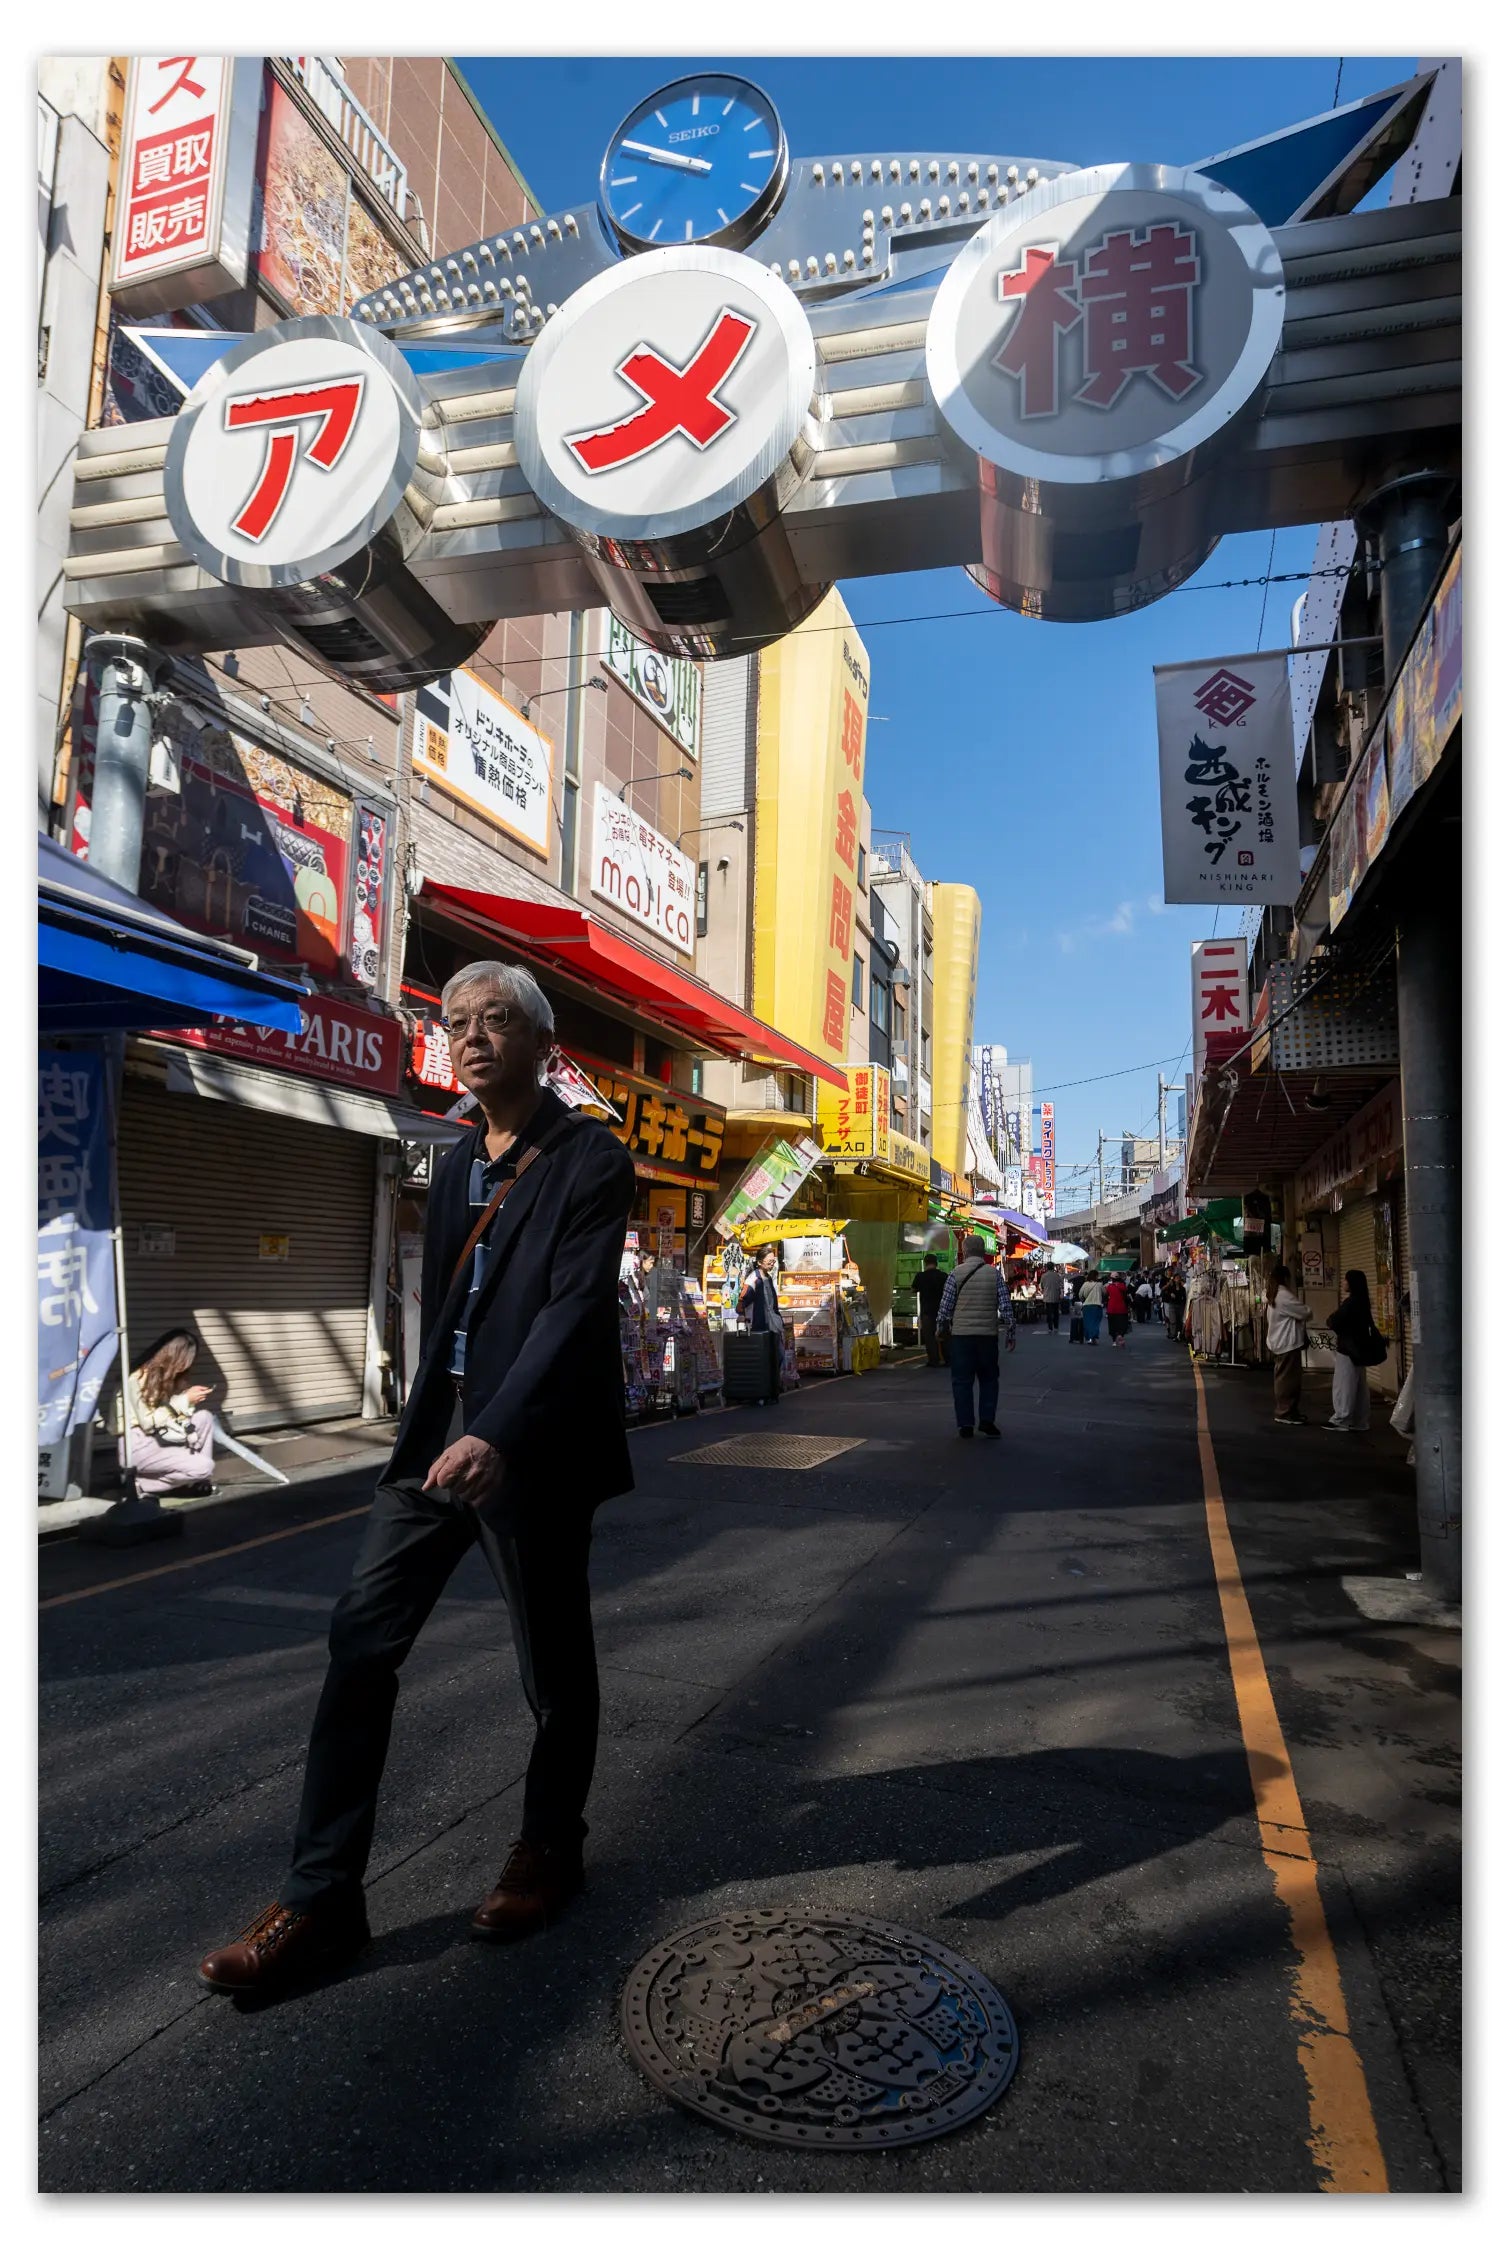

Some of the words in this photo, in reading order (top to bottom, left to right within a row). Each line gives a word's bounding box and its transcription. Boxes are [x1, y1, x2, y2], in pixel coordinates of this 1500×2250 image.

[669, 124, 720, 143] SEIKO
[136, 131, 211, 190] 買取
[129, 195, 205, 254] 販売
[454, 717, 546, 796] オリジナル商品ブランド
[474, 753, 527, 810] 情熱価格
[1185, 732, 1252, 865] 西成キング
[1256, 757, 1274, 843] ホルモン酒場
[608, 810, 632, 828] ドンキの
[638, 824, 681, 868] 電子マネー
[668, 870, 691, 901] 登場!!
[822, 687, 862, 1053] 現金問屋
[1200, 873, 1274, 882] NISHINARI
[1219, 883, 1254, 892] KING
[251, 921, 292, 944] CHANEL
[285, 1010, 383, 1072] PARIS
[855, 1072, 869, 1114] 御徒町
[837, 1098, 851, 1140] プラザ
[1043, 1120, 1052, 1158] ダイコク
[843, 1141, 865, 1152] 入口
[803, 1248, 822, 1257] mini
